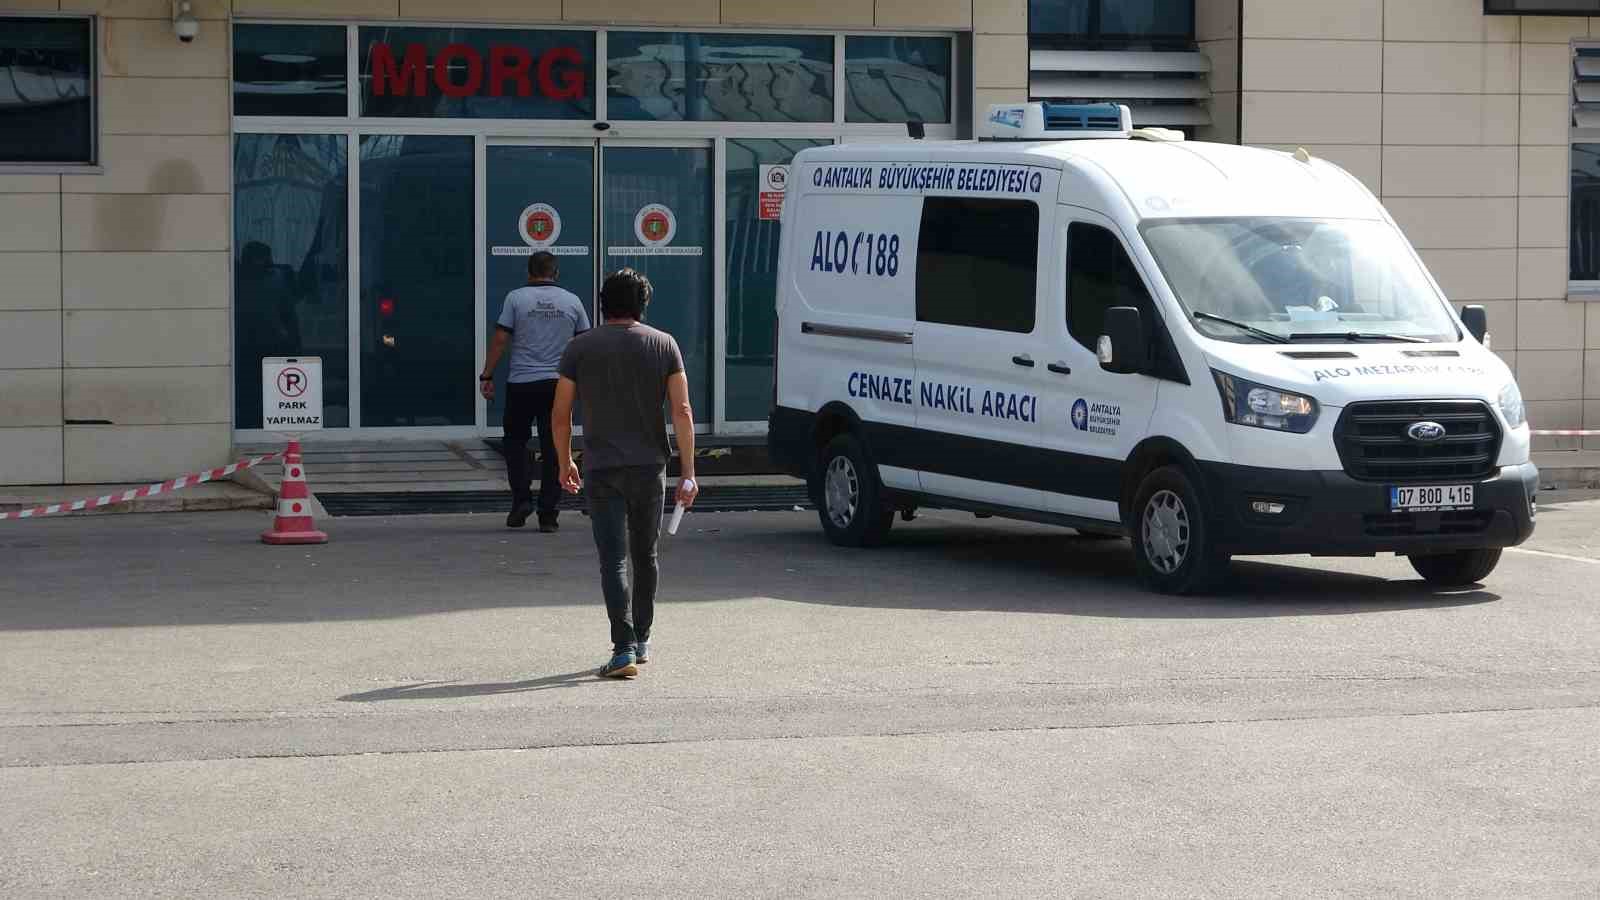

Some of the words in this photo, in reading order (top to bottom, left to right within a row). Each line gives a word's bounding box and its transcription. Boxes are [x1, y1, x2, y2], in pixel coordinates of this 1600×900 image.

[372, 43, 585, 100] MORG
[824, 167, 872, 189] ANTALYA
[879, 163, 954, 193] BÜYÜKŞEHİR
[957, 166, 1029, 193] BELEDİYESİ
[811, 231, 849, 274] ALO
[867, 233, 900, 277] 188
[1314, 367, 1350, 381] ALO
[279, 401, 307, 409] PARK
[848, 372, 912, 404] CENAZE
[982, 391, 1036, 423] ARACI
[1091, 403, 1120, 417] ANTALYA
[267, 416, 320, 425] YAPILMAZ
[1399, 488, 1414, 505] 07
[1449, 487, 1471, 503] 416
